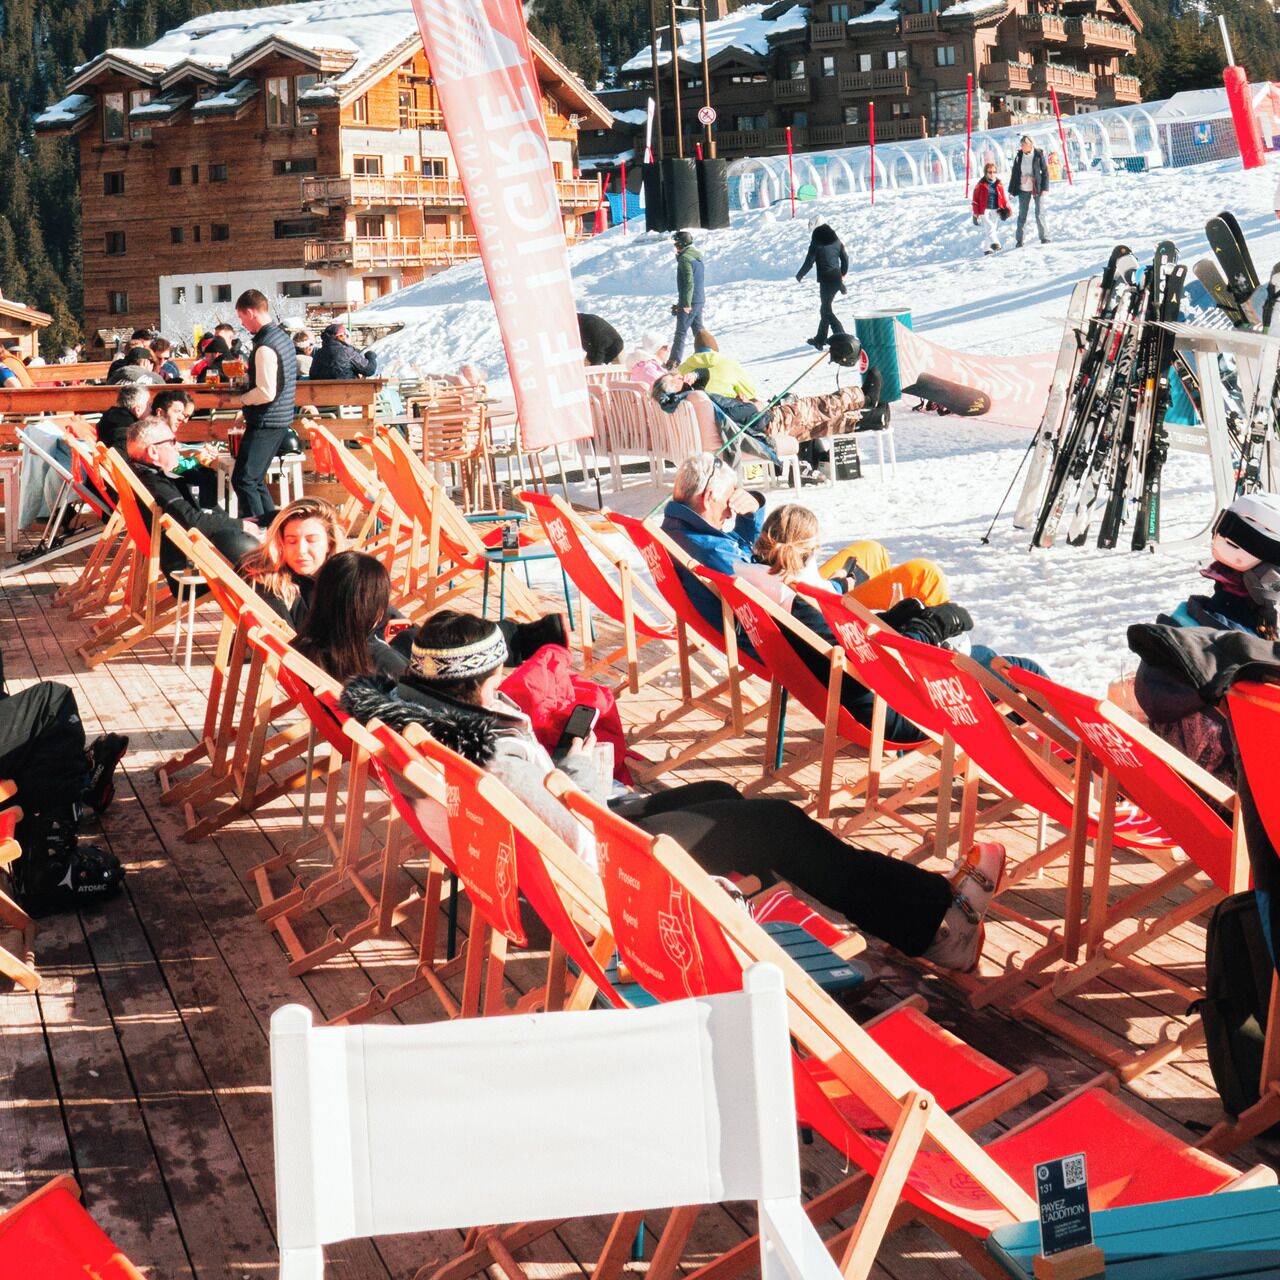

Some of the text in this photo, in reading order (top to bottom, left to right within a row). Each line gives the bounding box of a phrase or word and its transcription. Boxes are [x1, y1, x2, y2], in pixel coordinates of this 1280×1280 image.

[852, 640, 879, 664] SPRITZ
[924, 676, 973, 709] APEROL
[943, 702, 980, 728] SPRITZ
[1075, 716, 1134, 748] APEROL
[1102, 742, 1145, 769] SPRITZ
[78, 883, 108, 894] ATOMIC
[618, 867, 641, 891] Prosecco
[622, 908, 639, 928] Aperol
[1039, 1183, 1053, 1195] 131
[1041, 1198, 1066, 1214] PAYEZ
[1042, 1203, 1086, 1224] L'ADDITION
